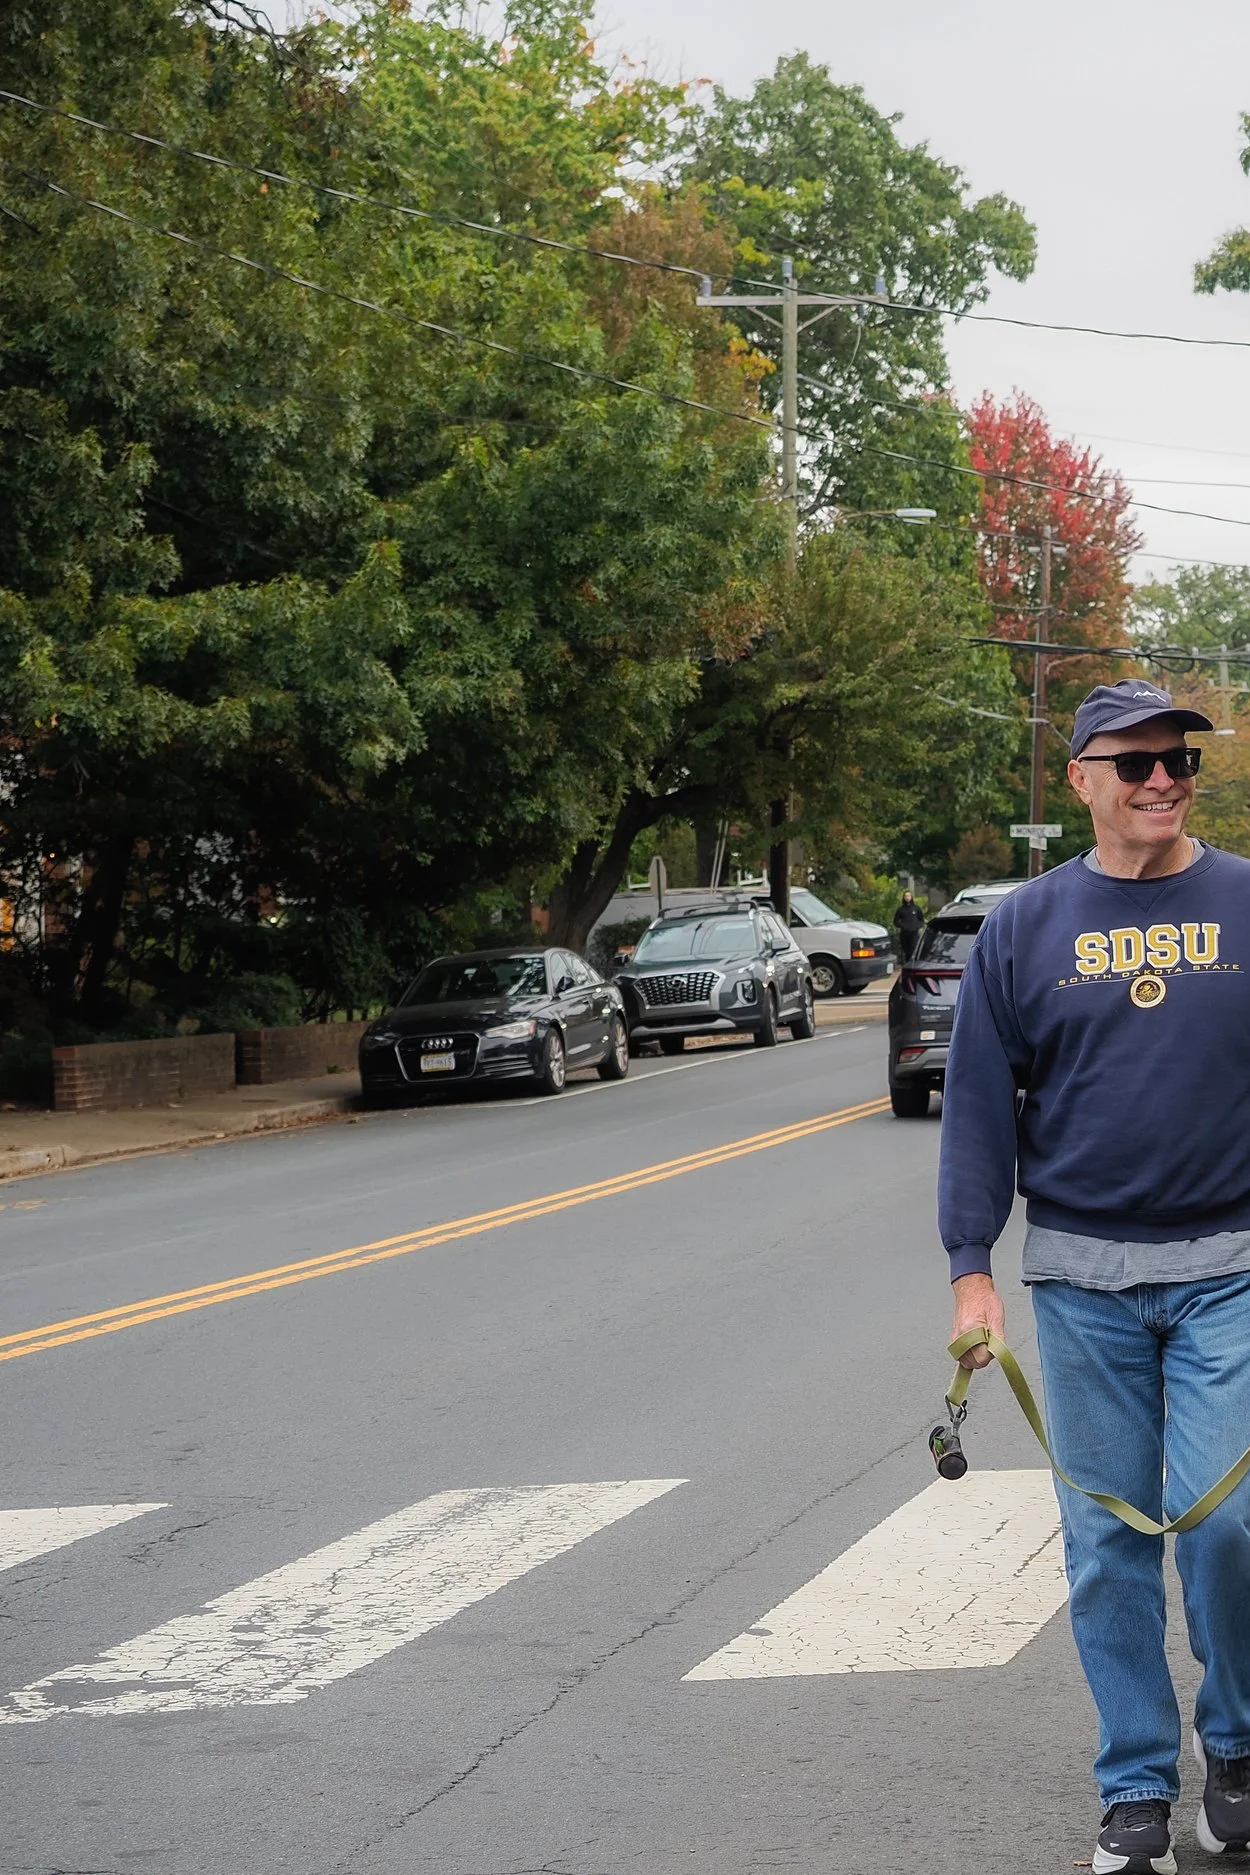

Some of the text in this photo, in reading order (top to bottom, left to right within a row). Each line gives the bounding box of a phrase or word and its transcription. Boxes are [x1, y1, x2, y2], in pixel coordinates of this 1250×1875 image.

[1074, 922, 1221, 975] SDSU
[1058, 973, 1112, 986] SOUTH
[1121, 967, 1183, 977] DAKOTA
